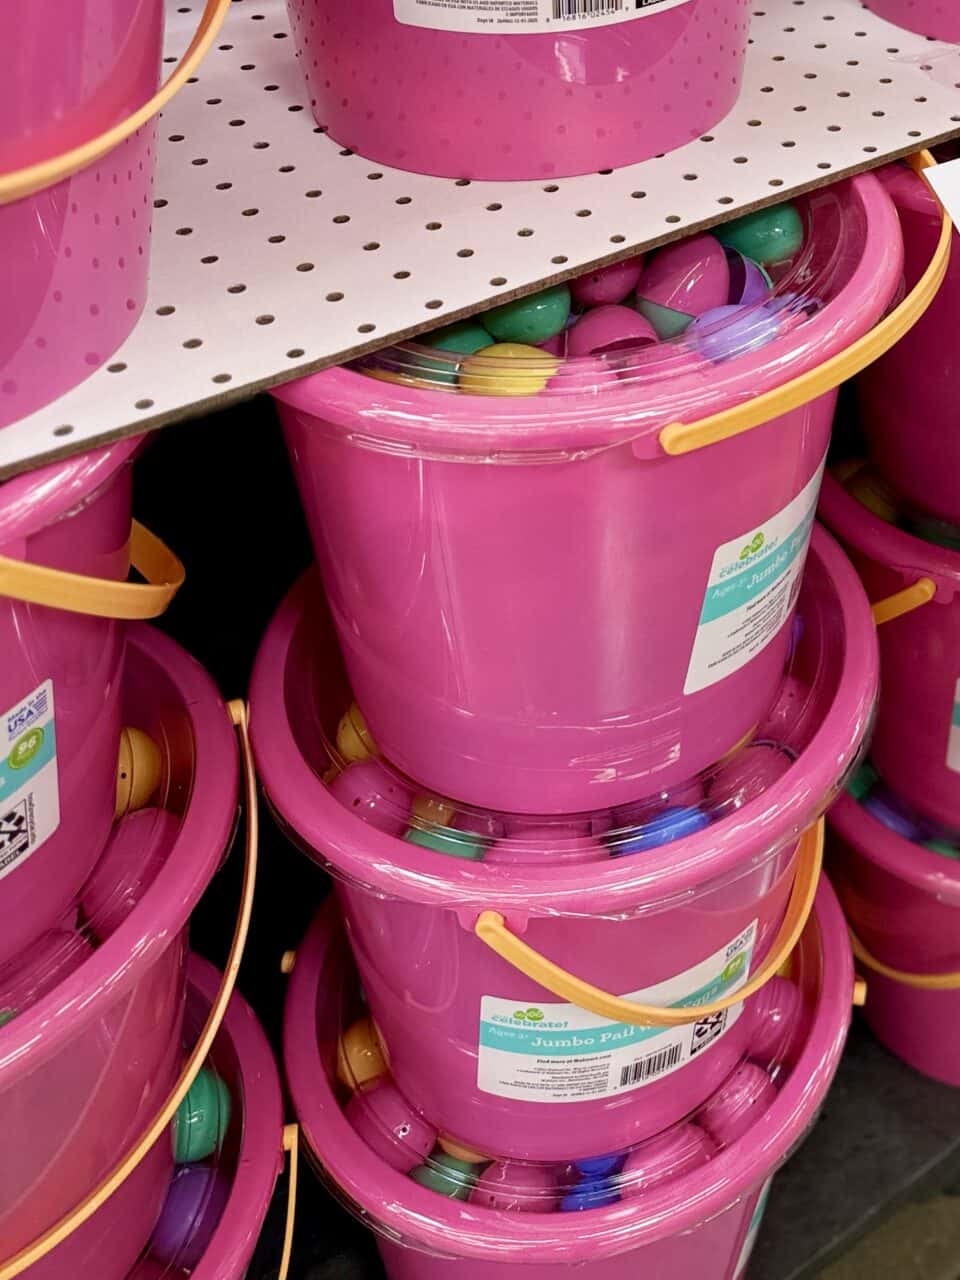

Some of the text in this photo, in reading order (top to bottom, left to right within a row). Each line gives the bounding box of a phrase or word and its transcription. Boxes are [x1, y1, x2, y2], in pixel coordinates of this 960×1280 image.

[8, 709, 34, 733] USA
[490, 1014, 569, 1029] celebrate!
[531, 1035, 595, 1048] Jumbo
[600, 1025, 636, 1042] Pail
